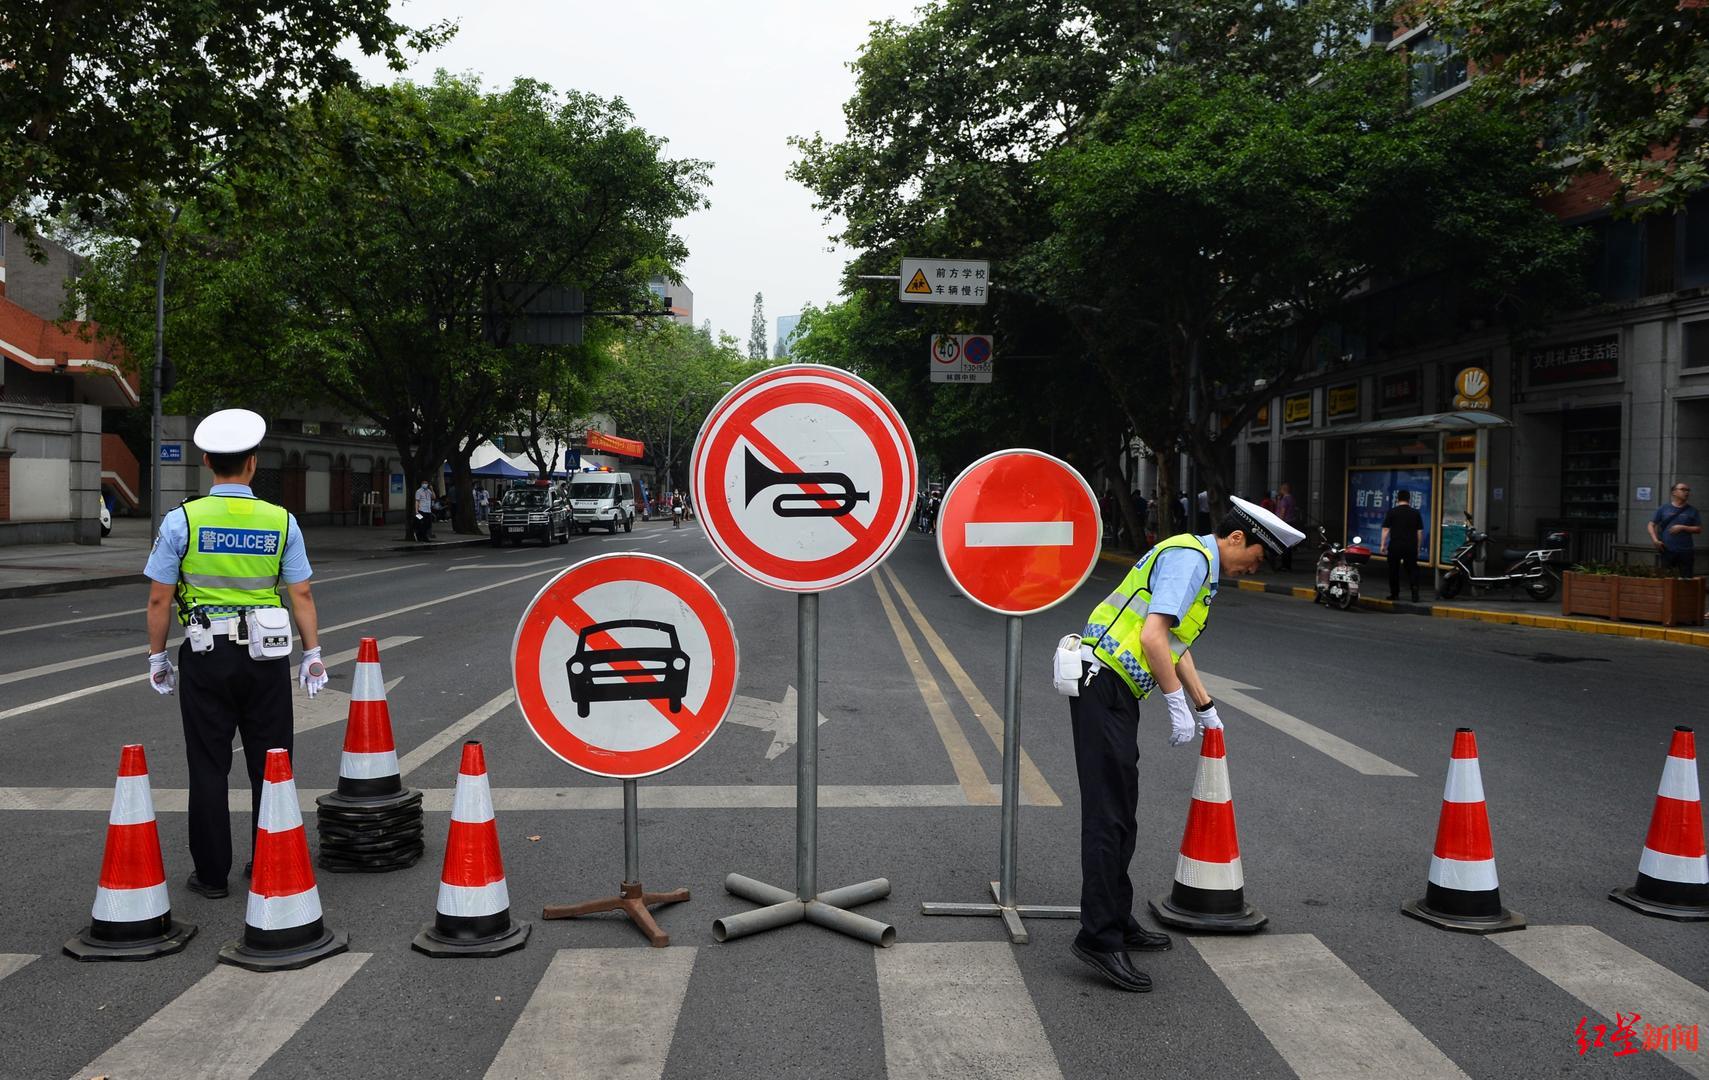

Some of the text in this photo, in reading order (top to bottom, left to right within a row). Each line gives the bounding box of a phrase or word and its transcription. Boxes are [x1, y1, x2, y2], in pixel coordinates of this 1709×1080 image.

[936, 268, 985, 279] 前方学校
[935, 285, 985, 296] 车辆慢行
[939, 343, 954, 358] 40
[1533, 342, 1619, 369] 文具礼品生活馆
